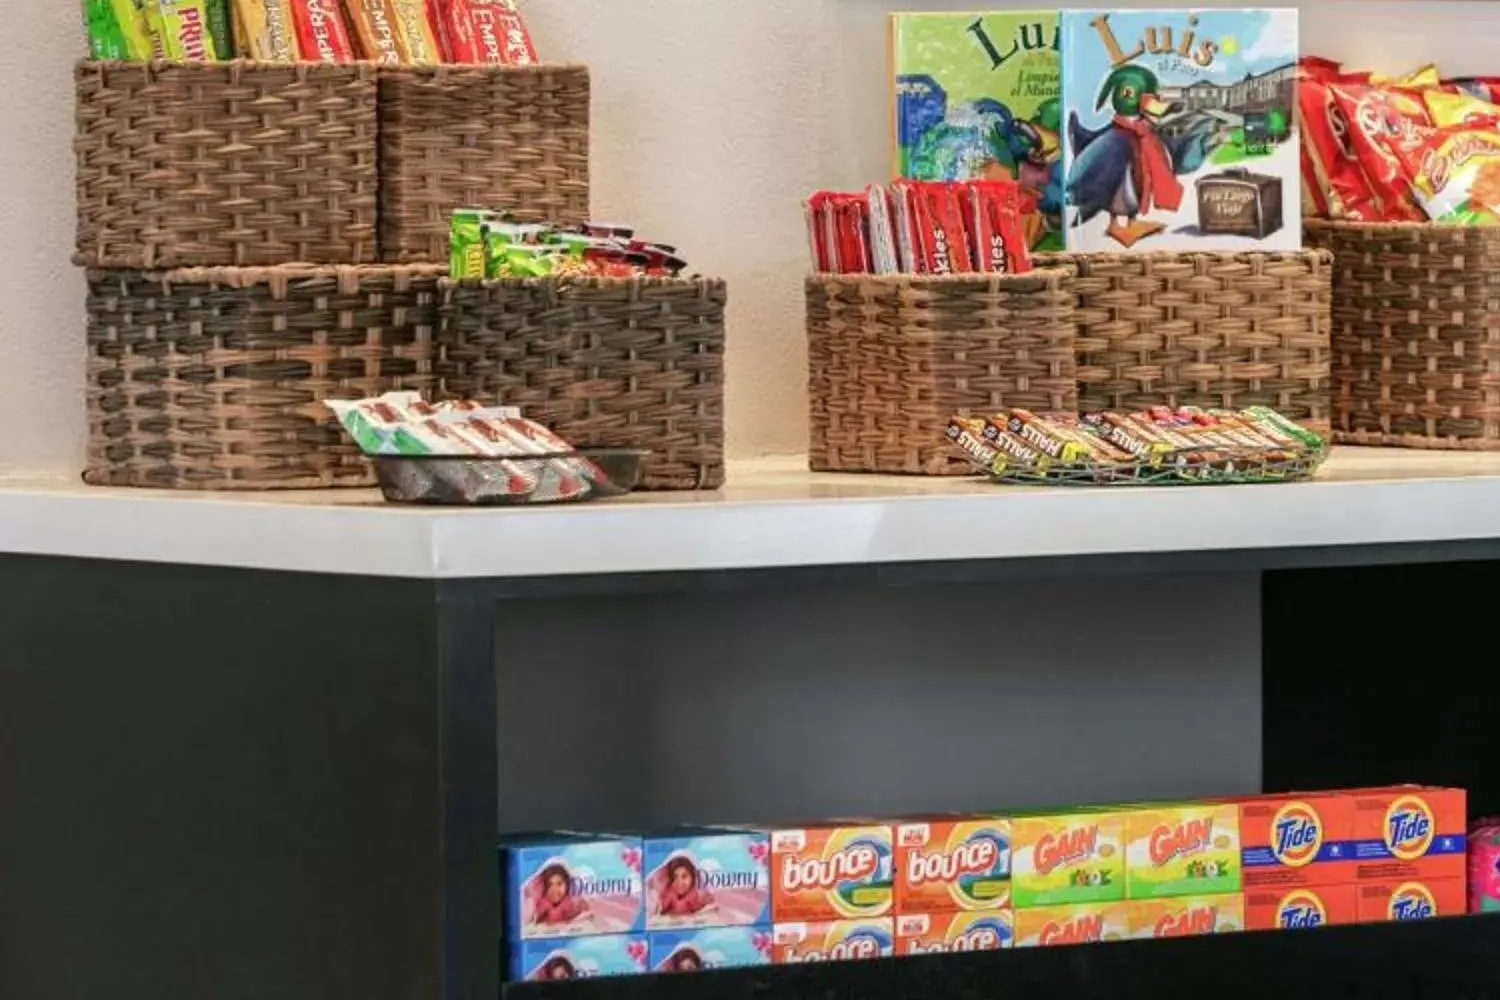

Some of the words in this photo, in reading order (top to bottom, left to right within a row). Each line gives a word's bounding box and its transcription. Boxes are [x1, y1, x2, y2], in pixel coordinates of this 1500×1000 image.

[1089, 13, 1219, 67] Luis
[957, 430, 997, 463] HALLS
[1020, 423, 1062, 458] HALLS
[1276, 817, 1317, 856] Tide
[1390, 810, 1429, 848] Tide
[696, 868, 759, 890] Downy
[783, 849, 873, 890] bounce
[909, 842, 993, 882] bounce
[570, 874, 632, 897] Downy
